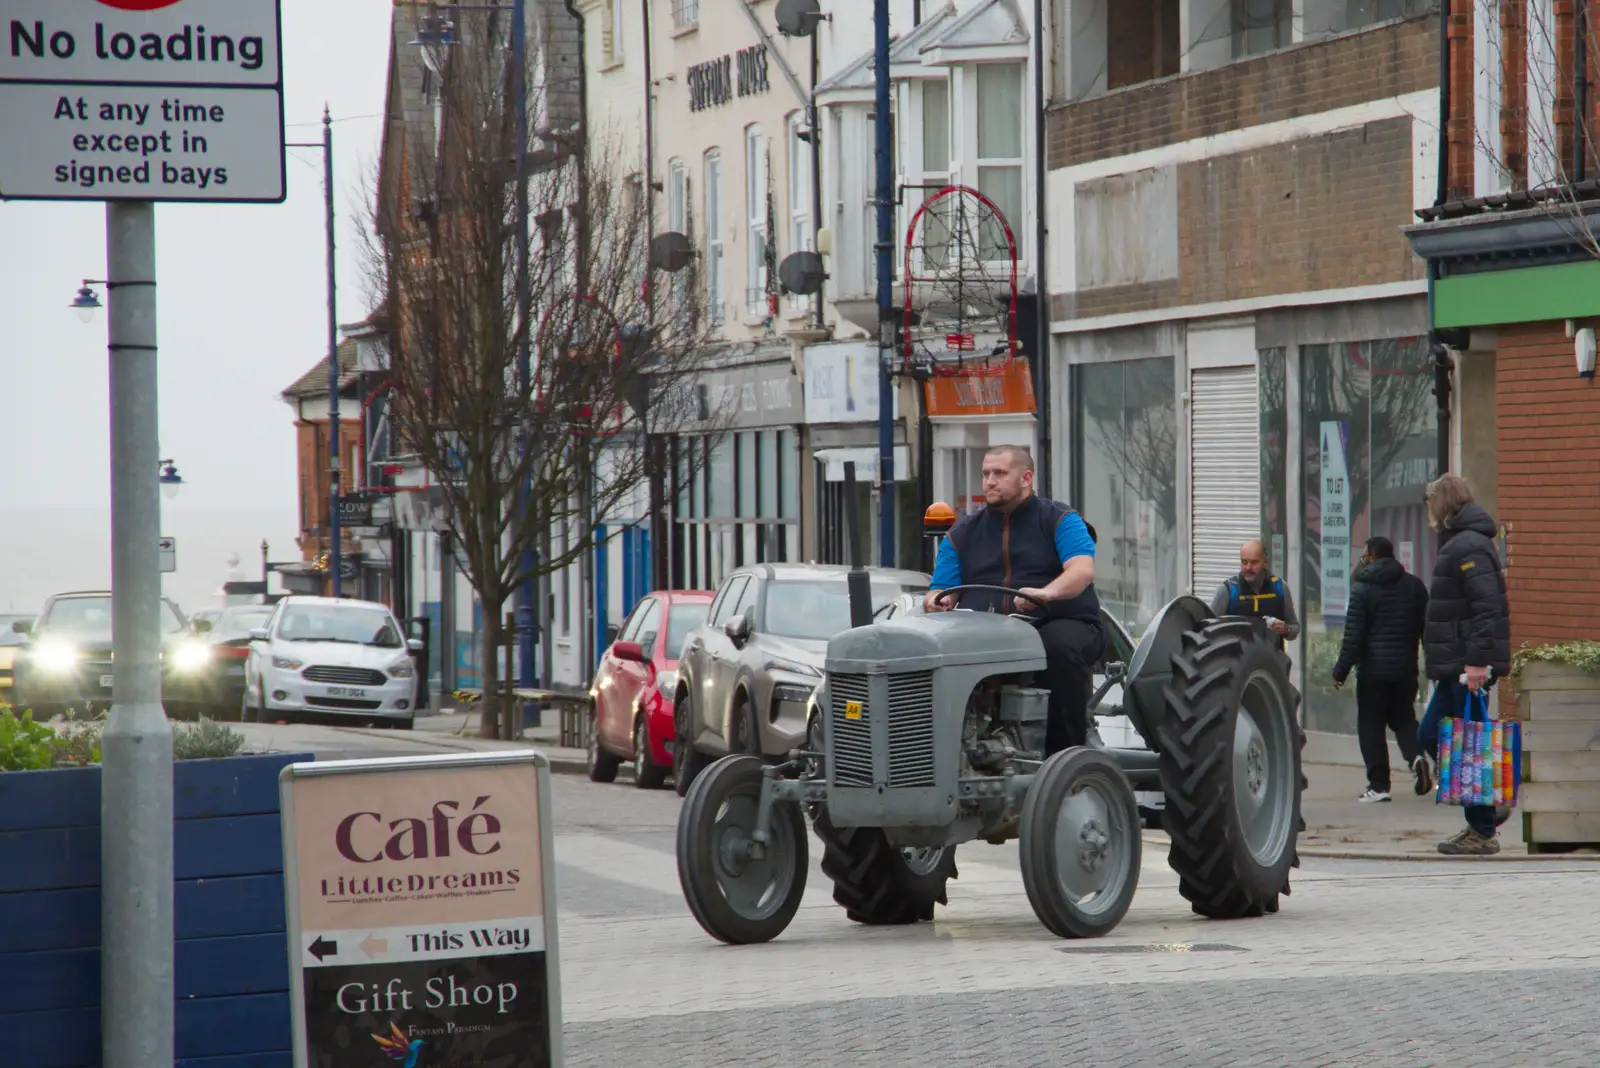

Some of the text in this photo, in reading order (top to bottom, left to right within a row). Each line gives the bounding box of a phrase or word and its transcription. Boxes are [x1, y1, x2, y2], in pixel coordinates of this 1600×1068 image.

[10, 20, 264, 70] No loading
[54, 96, 225, 126] At any time
[72, 130, 208, 157] except in
[55, 160, 228, 189] signed bays
[1335, 477, 1344, 494] LET
[335, 795, 502, 864] Café
[406, 928, 531, 953] This Way
[336, 974, 518, 1014] Gift Shop
